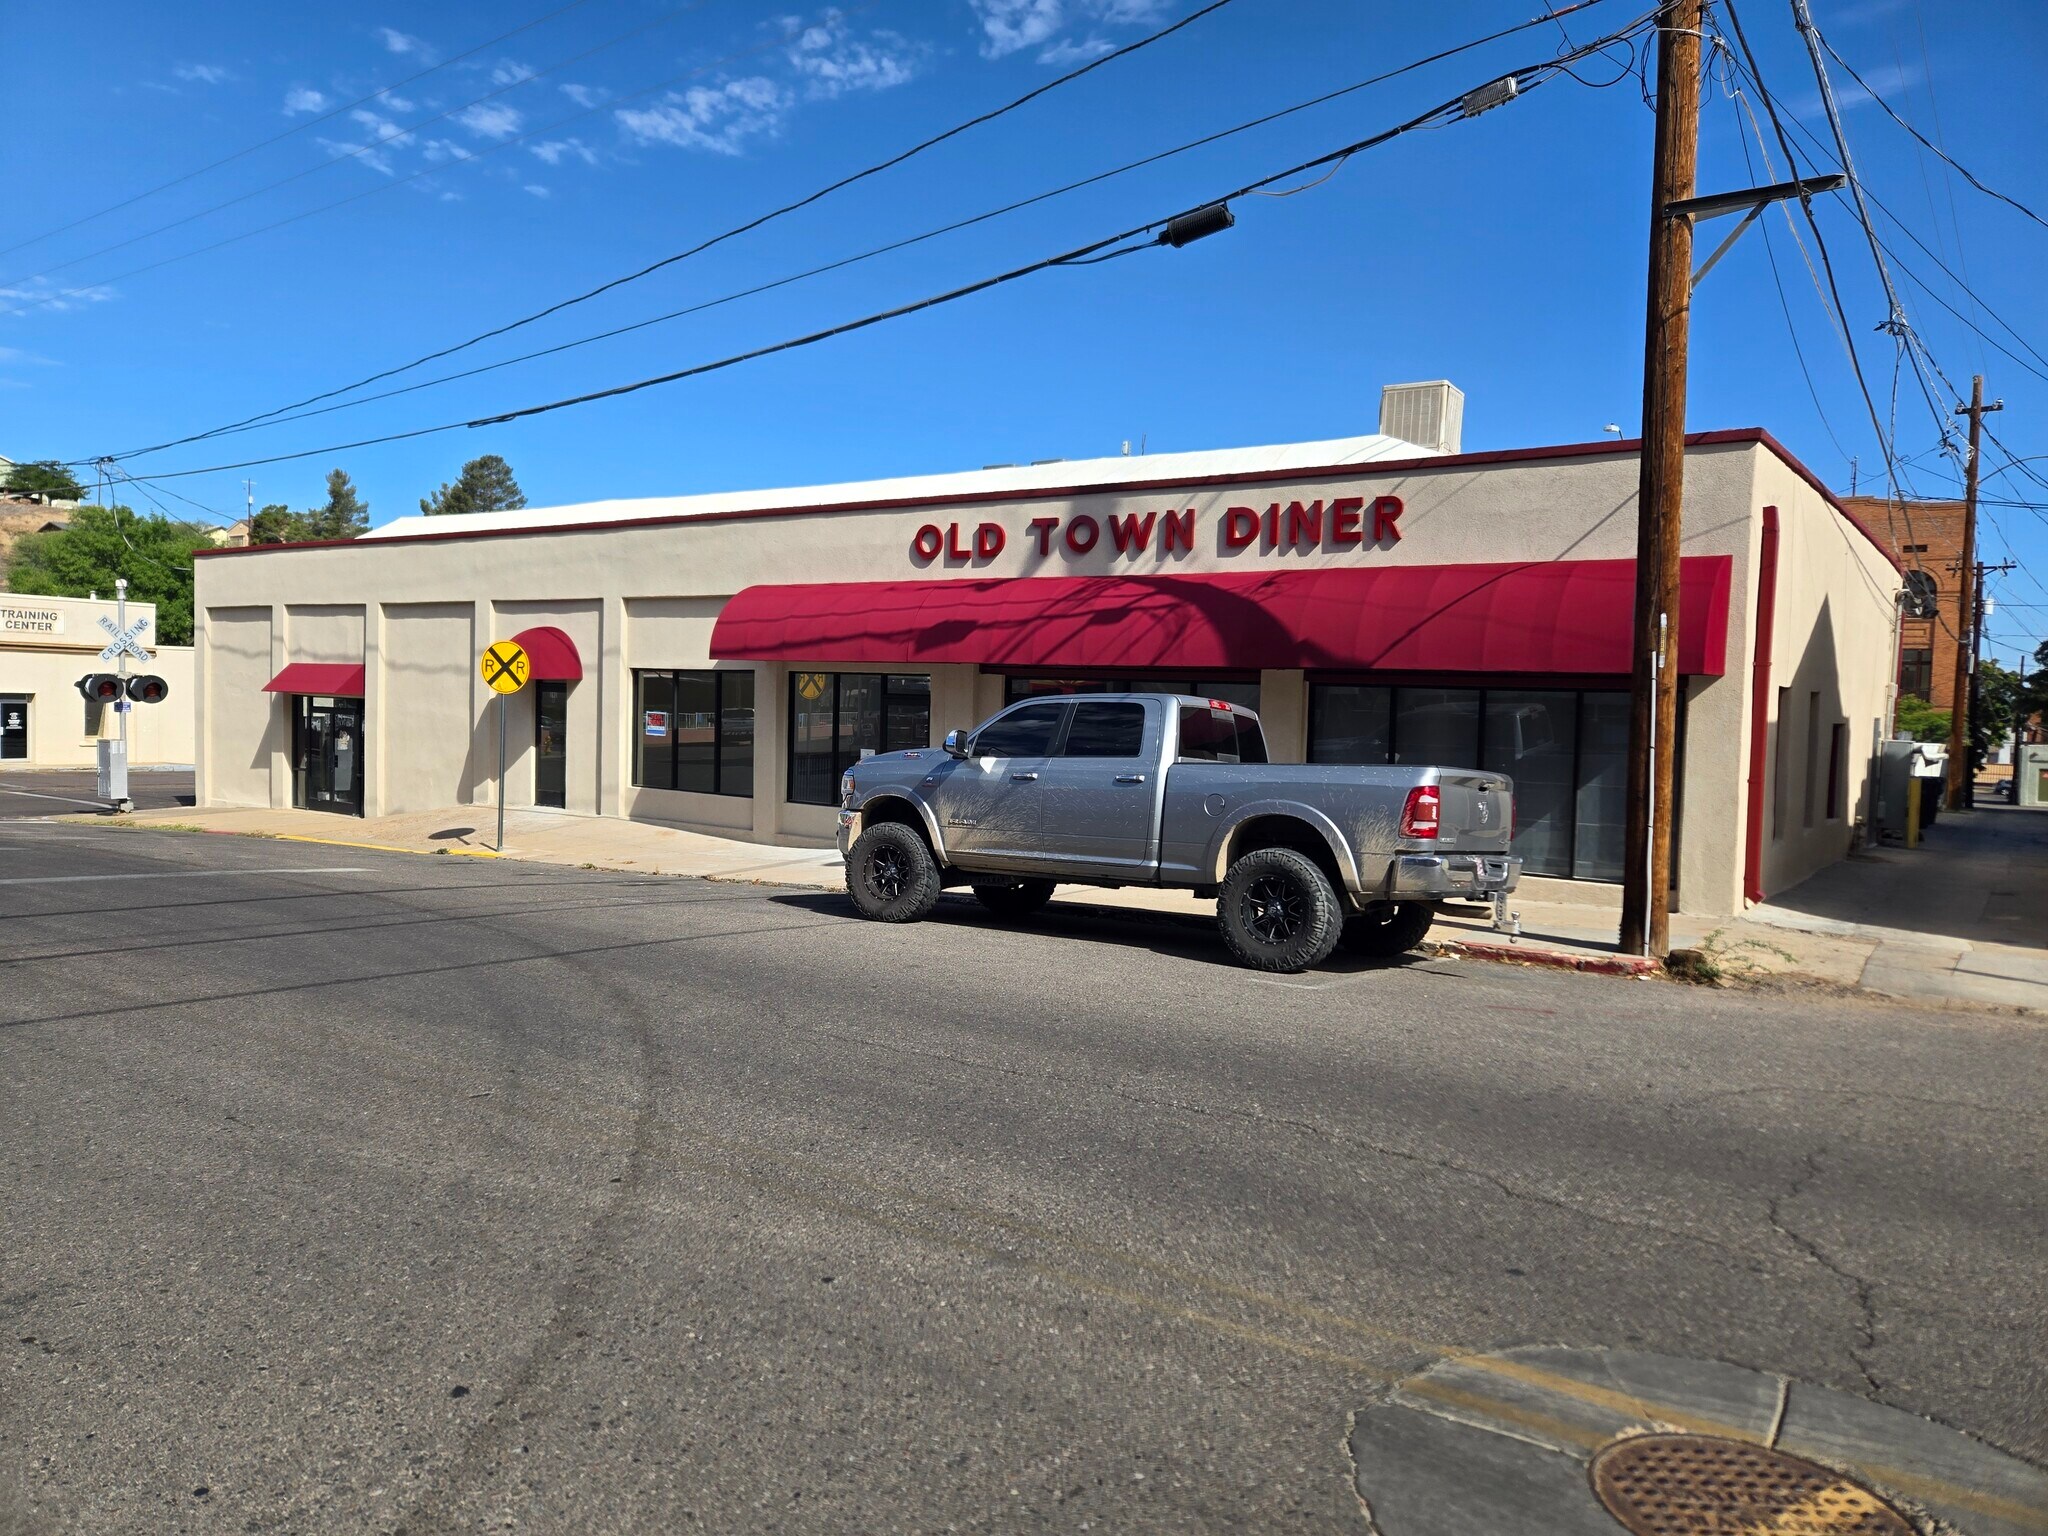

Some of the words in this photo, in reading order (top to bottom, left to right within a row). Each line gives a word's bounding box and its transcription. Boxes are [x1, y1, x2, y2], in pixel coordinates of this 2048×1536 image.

[915, 522, 1007, 560] OLD
[1032, 508, 1196, 556] TOWN
[1226, 495, 1405, 548] DINER
[0, 609, 58, 621] TRAINING
[5, 620, 53, 631] CENTER
[101, 619, 148, 661] CROSSING
